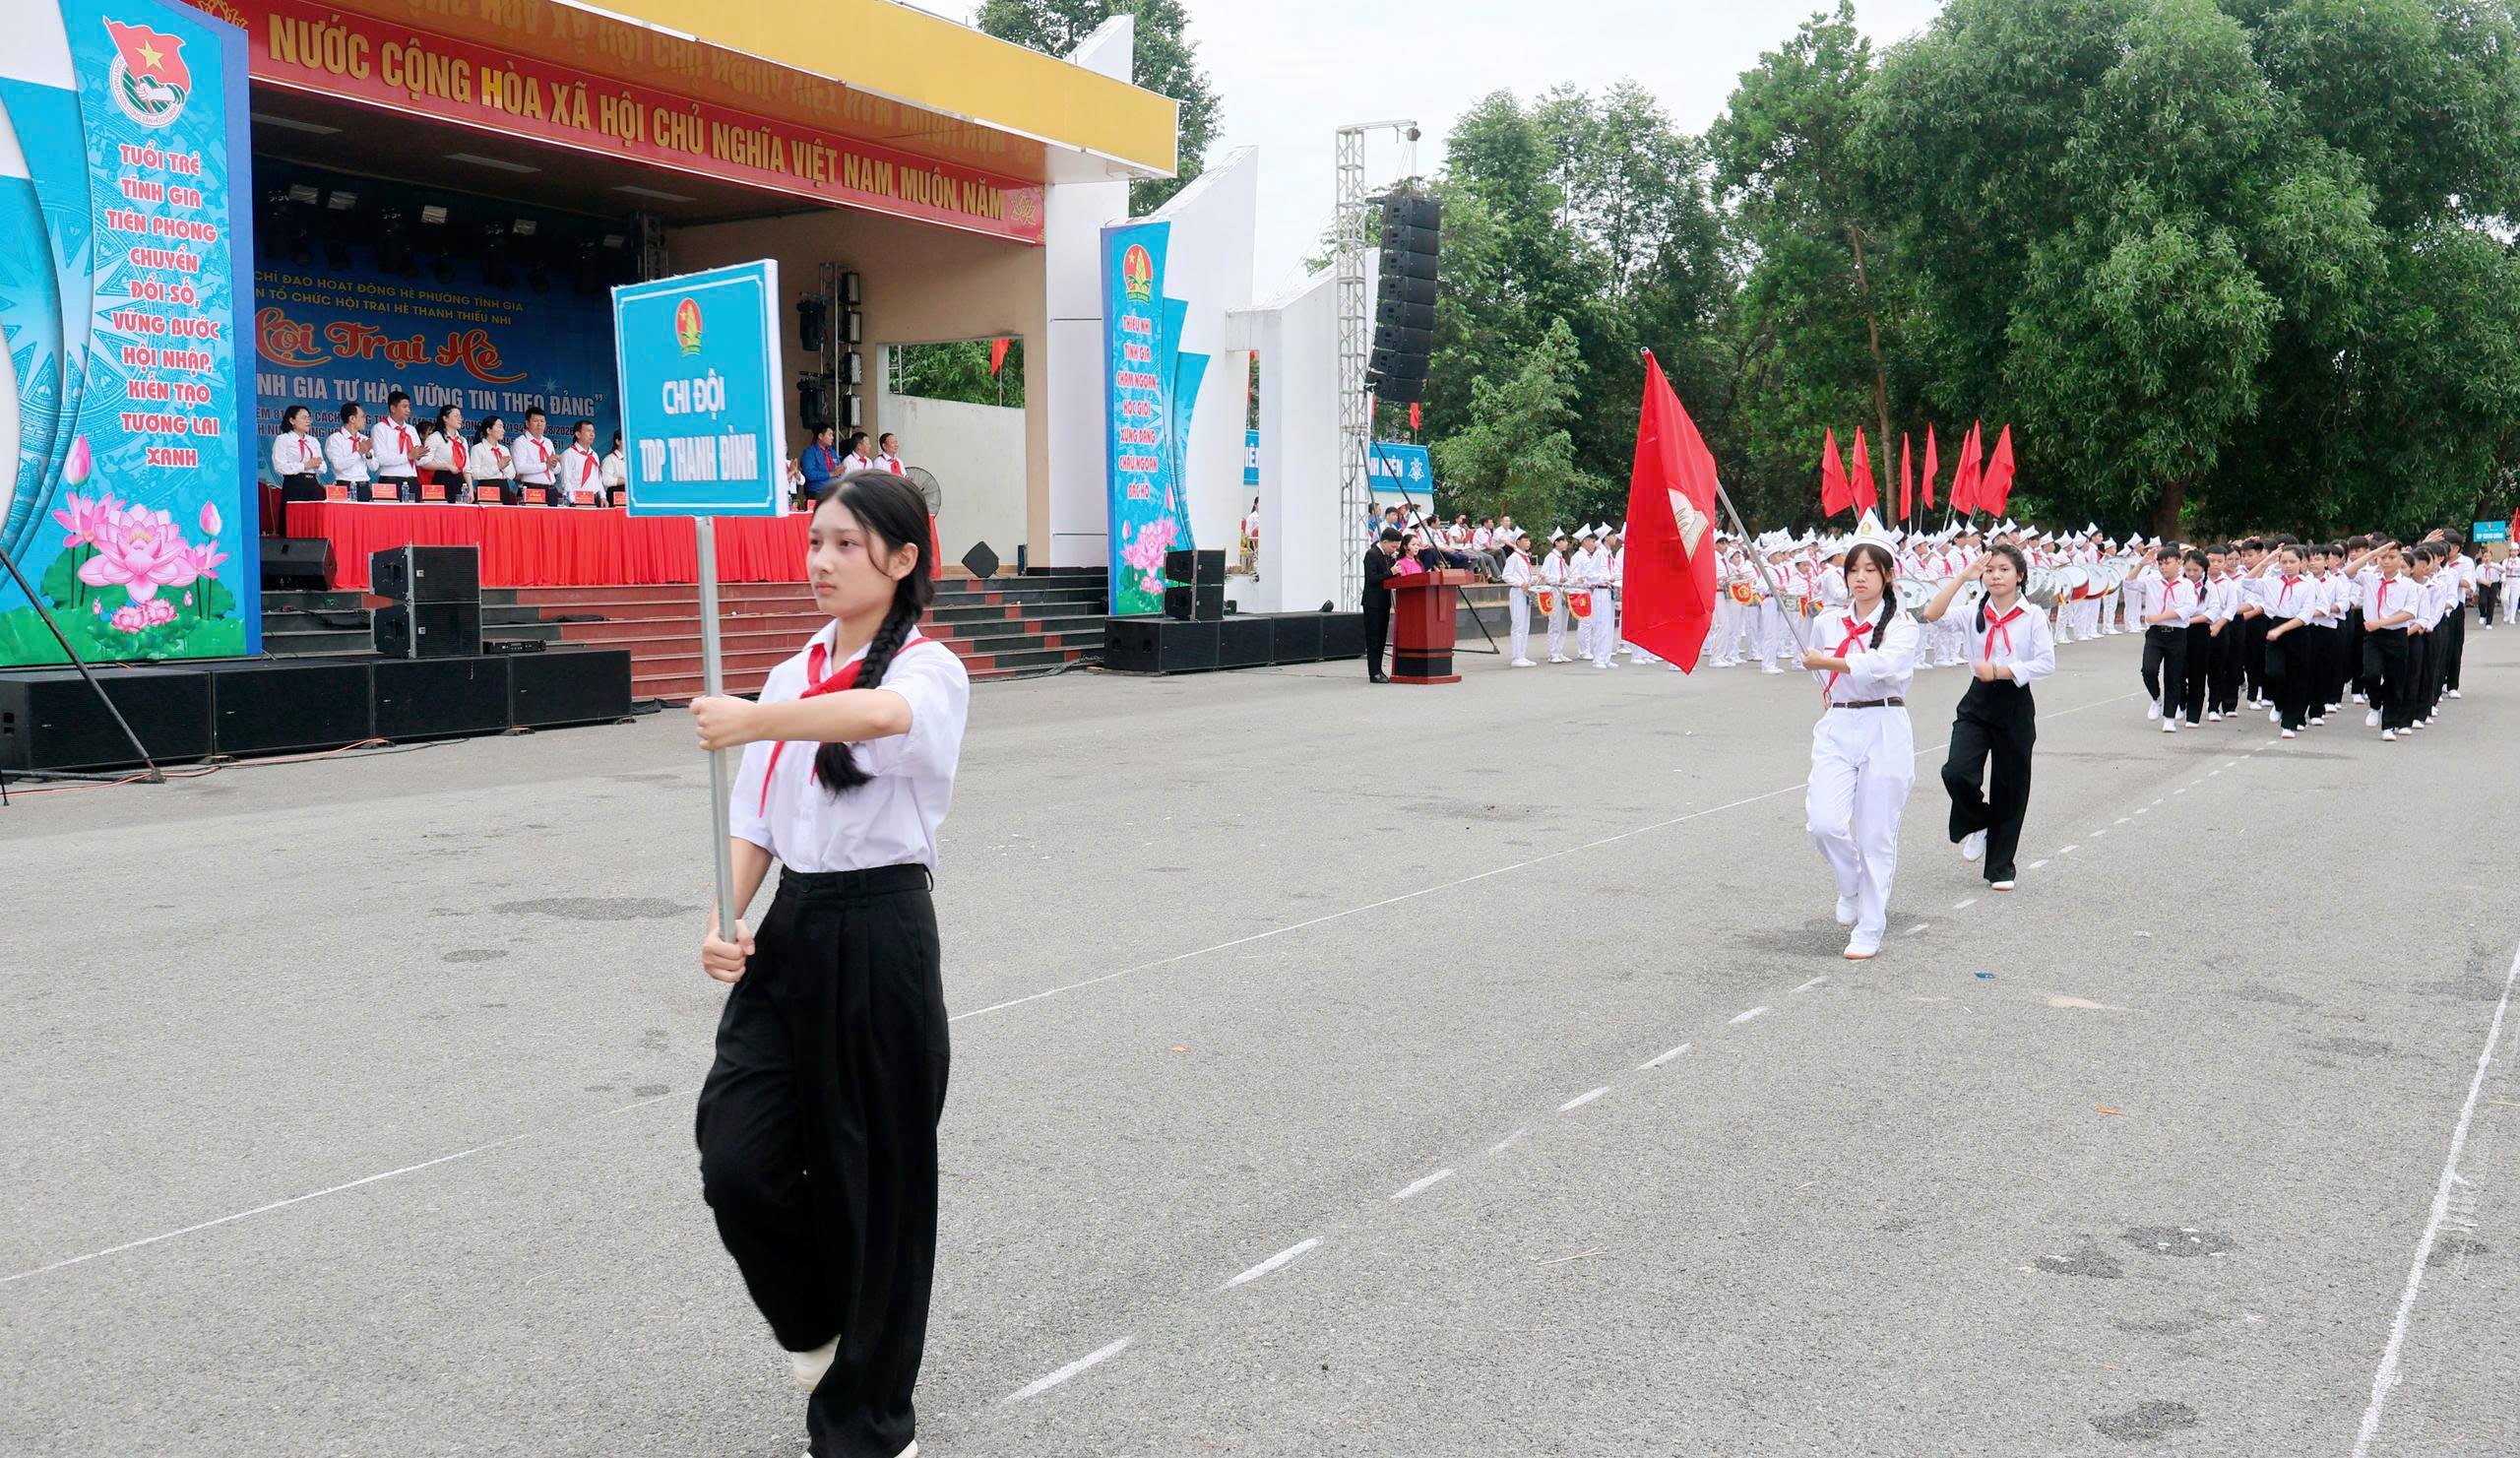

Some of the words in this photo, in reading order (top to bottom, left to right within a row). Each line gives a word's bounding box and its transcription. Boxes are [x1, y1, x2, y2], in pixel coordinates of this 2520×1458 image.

[269, 14, 370, 80] NƯỚC
[381, 38, 471, 103] CỘNG
[481, 61, 542, 119] HÒA
[550, 81, 591, 130] XÃ
[599, 91, 645, 147] HỘI
[653, 103, 704, 155] CHỦ
[712, 120, 785, 172] NGHĨA
[791, 139, 837, 187] VIỆT
[844, 152, 893, 196] NAM
[900, 165, 957, 211] MUÔN
[962, 177, 1005, 221] NĂM
[120, 141, 163, 169] TUỔI
[168, 152, 201, 175] TRẺ
[121, 176, 163, 202] TĨNH
[168, 186, 201, 208] GIA
[106, 208, 147, 233] TIÊN
[153, 217, 217, 242] PHONG
[130, 244, 198, 273] CHUYỂN
[130, 274, 164, 301] ĐỔI
[169, 278, 200, 308] SỐ,
[269, 285, 287, 299] TỔ
[292, 292, 331, 305] CHỨC
[336, 297, 359, 310] HỘI
[363, 300, 390, 314] TRẠI
[394, 303, 409, 314] HÈ
[413, 305, 453, 319] THANH
[457, 308, 488, 323] THIẾU
[492, 315, 512, 325] NHI
[283, 275, 313, 287] ĐẠO
[317, 279, 353, 293] HOẠT
[401, 287, 415, 298] HÈ
[502, 301, 524, 311] GIA
[112, 308, 165, 334] VỮNG
[171, 315, 220, 340] BƯỚC
[123, 343, 157, 372] HỘI
[162, 347, 212, 376] NHẬP,
[325, 321, 431, 370] Trại
[435, 329, 528, 384] Hè
[128, 372, 169, 400] KIẾN
[174, 383, 211, 409] TẠO
[257, 373, 285, 397] NH
[293, 376, 328, 400] GIA
[413, 382, 463, 408] VỮNG
[469, 389, 497, 412] TIN
[662, 379, 691, 415] CHI
[693, 367, 726, 421] ĐỘI
[121, 413, 188, 434] TƯƠNG
[193, 417, 219, 435] LAI
[147, 447, 198, 467] XANH
[667, 435, 718, 482] THANH
